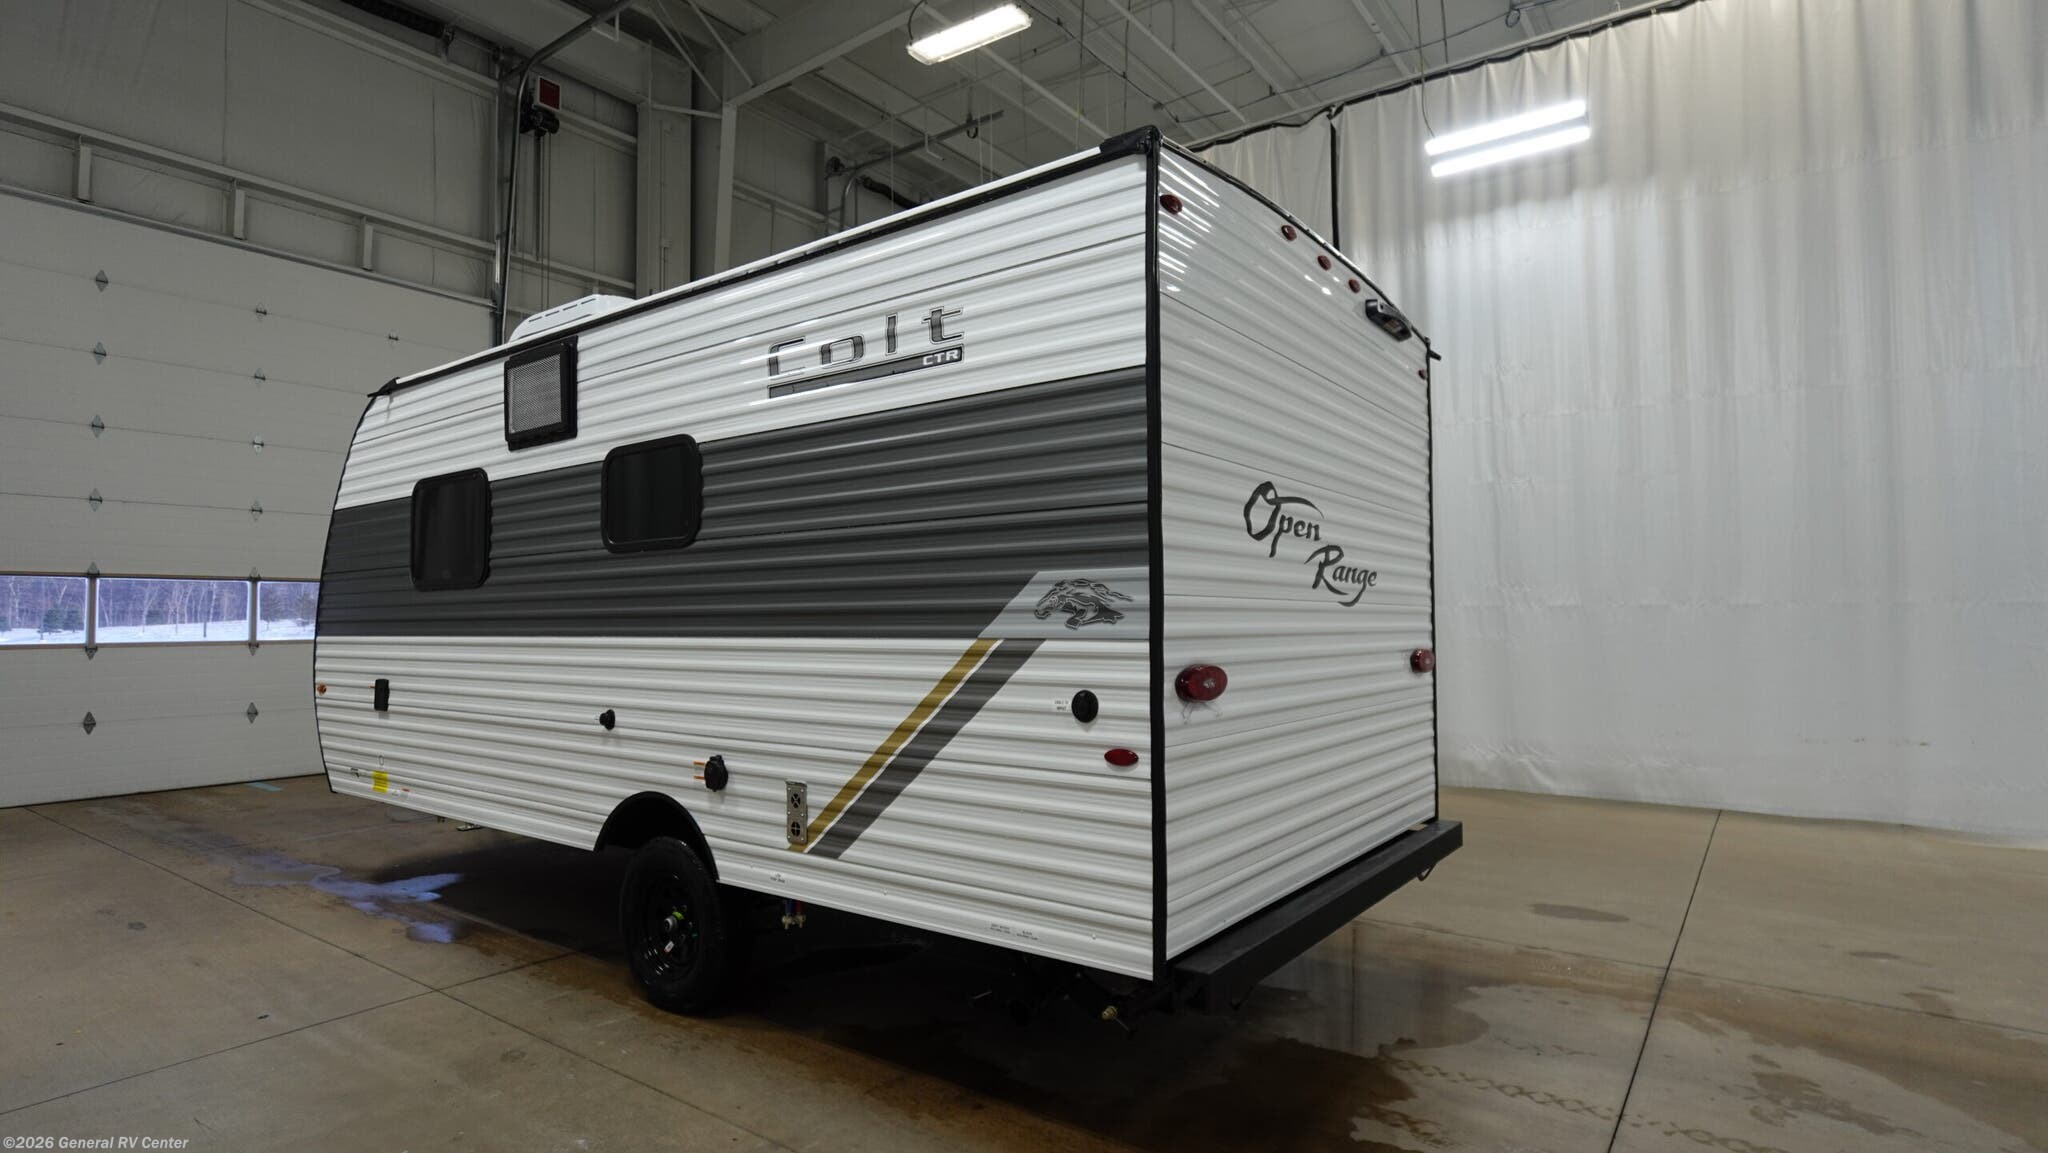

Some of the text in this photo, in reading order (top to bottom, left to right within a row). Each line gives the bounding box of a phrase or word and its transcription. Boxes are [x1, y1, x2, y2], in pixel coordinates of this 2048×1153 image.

[768, 306, 964, 379] Colt
[922, 349, 960, 366] CTR
[1243, 481, 1324, 558] Open
[1304, 544, 1377, 607] Range
